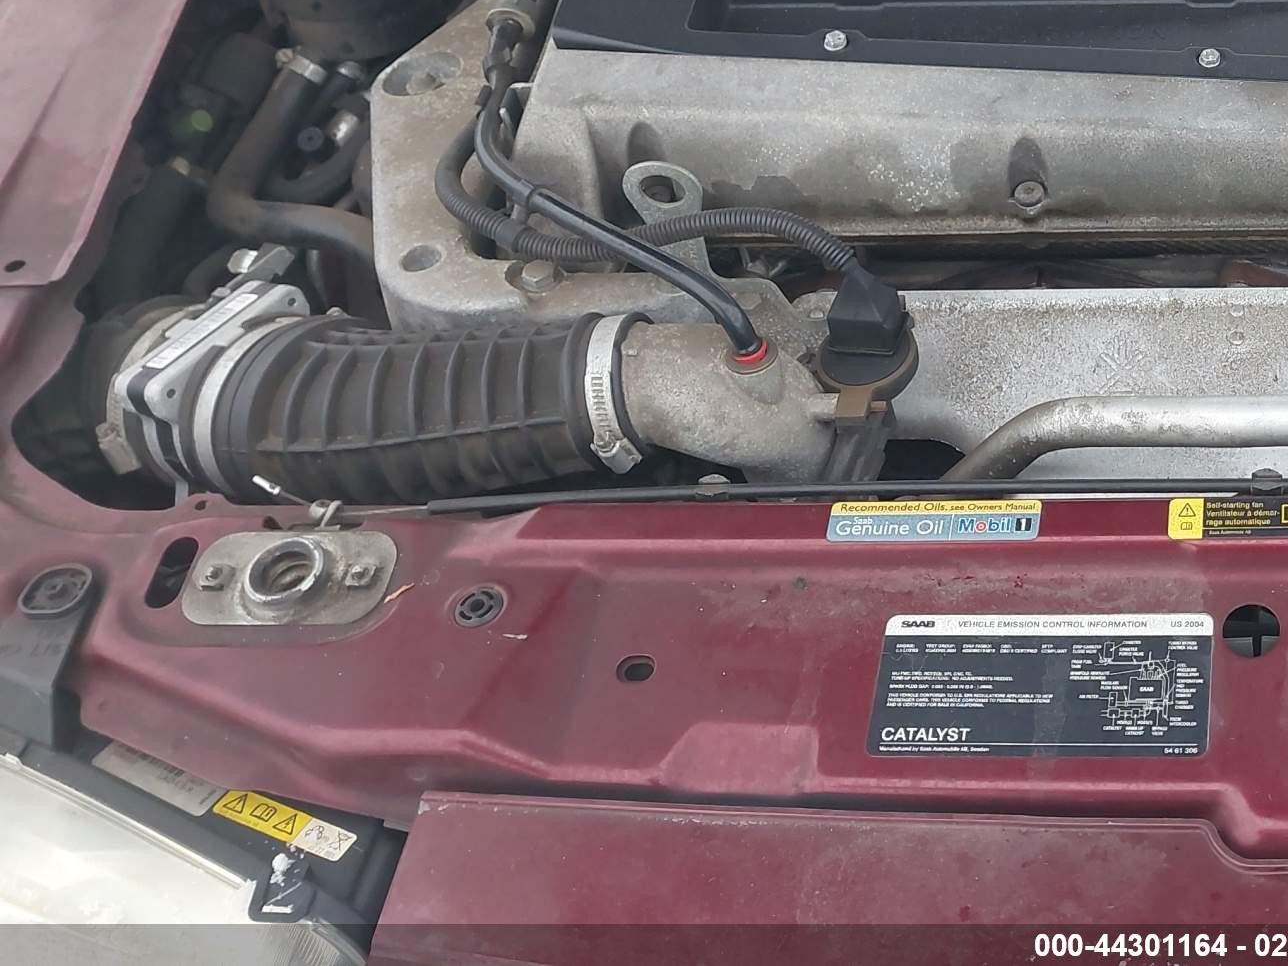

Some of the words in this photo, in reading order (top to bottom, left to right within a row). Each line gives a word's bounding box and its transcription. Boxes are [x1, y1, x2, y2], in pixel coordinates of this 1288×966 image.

[841, 504, 920, 512] Recommended
[968, 504, 1002, 512] Owners
[1006, 504, 1036, 512] Manual
[1206, 502, 1250, 510] Self-starting
[853, 517, 873, 525] Saab
[957, 517, 1011, 533] Mobil
[836, 520, 910, 535] Genuine
[916, 519, 944, 534] Oil
[957, 620, 994, 628] VEHICLE
[998, 620, 1039, 628] EMISSION
[1043, 620, 1084, 628] CONTROL
[1088, 620, 1148, 628] INFORMATION
[882, 728, 970, 741] CATALYST
